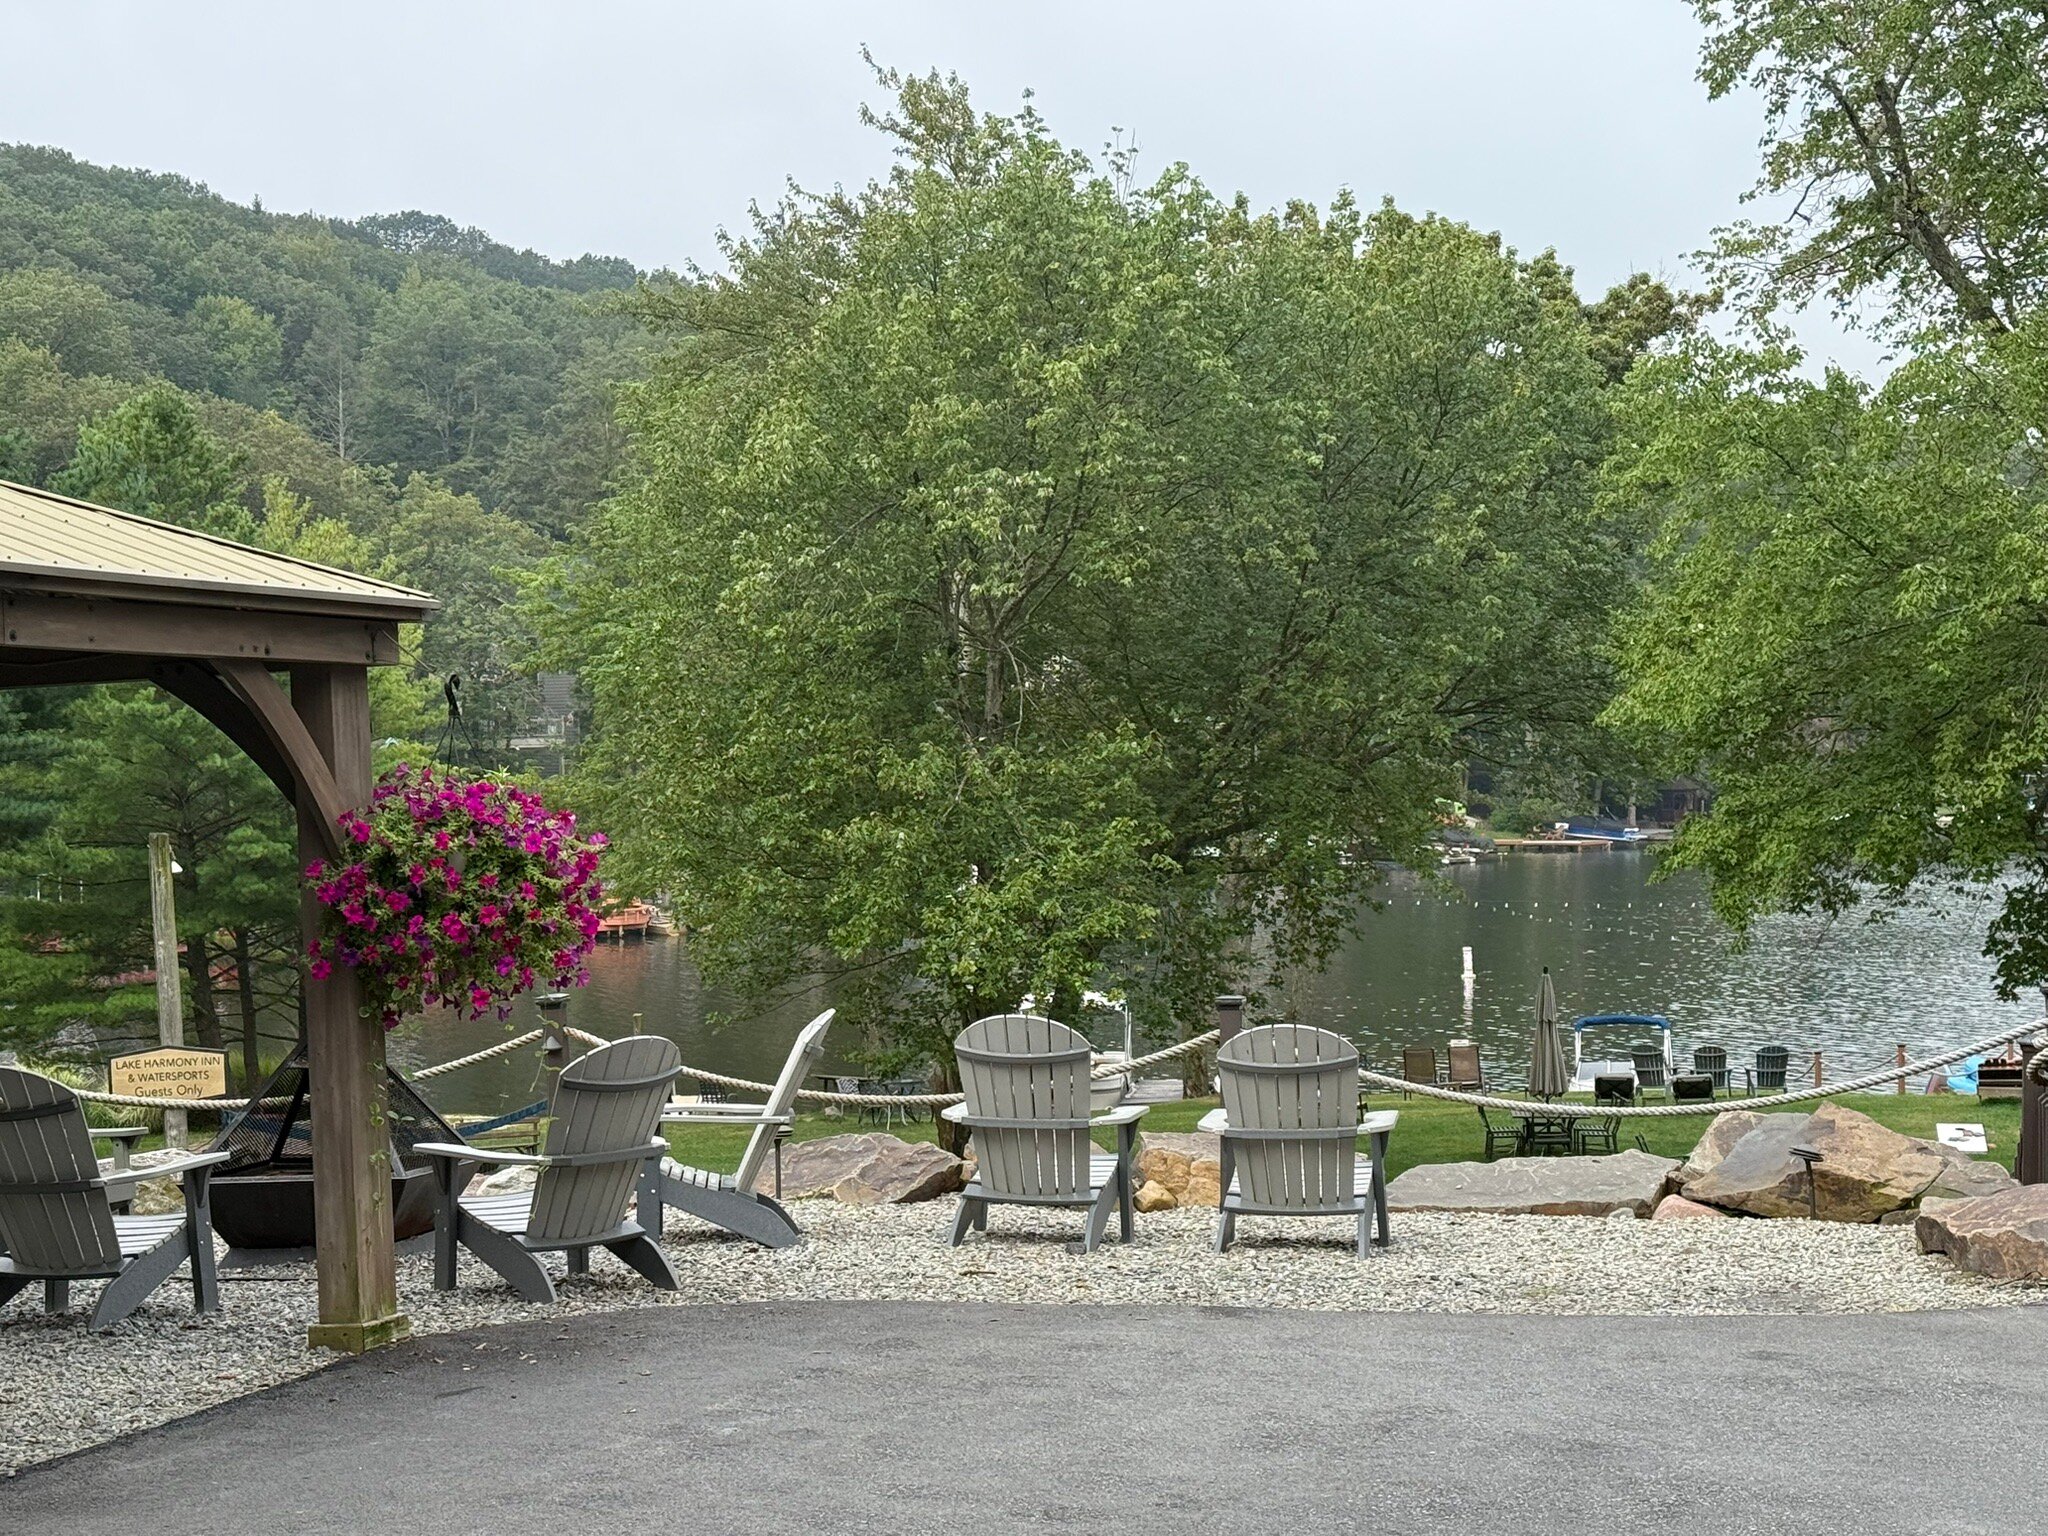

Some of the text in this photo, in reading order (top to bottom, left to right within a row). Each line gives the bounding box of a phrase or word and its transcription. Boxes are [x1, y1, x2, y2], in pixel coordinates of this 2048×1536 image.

[115, 1056, 221, 1070] LAKE HARMONY INN
[127, 1070, 210, 1083] & WATERSPORTS
[135, 1084, 203, 1097] Guests Only
